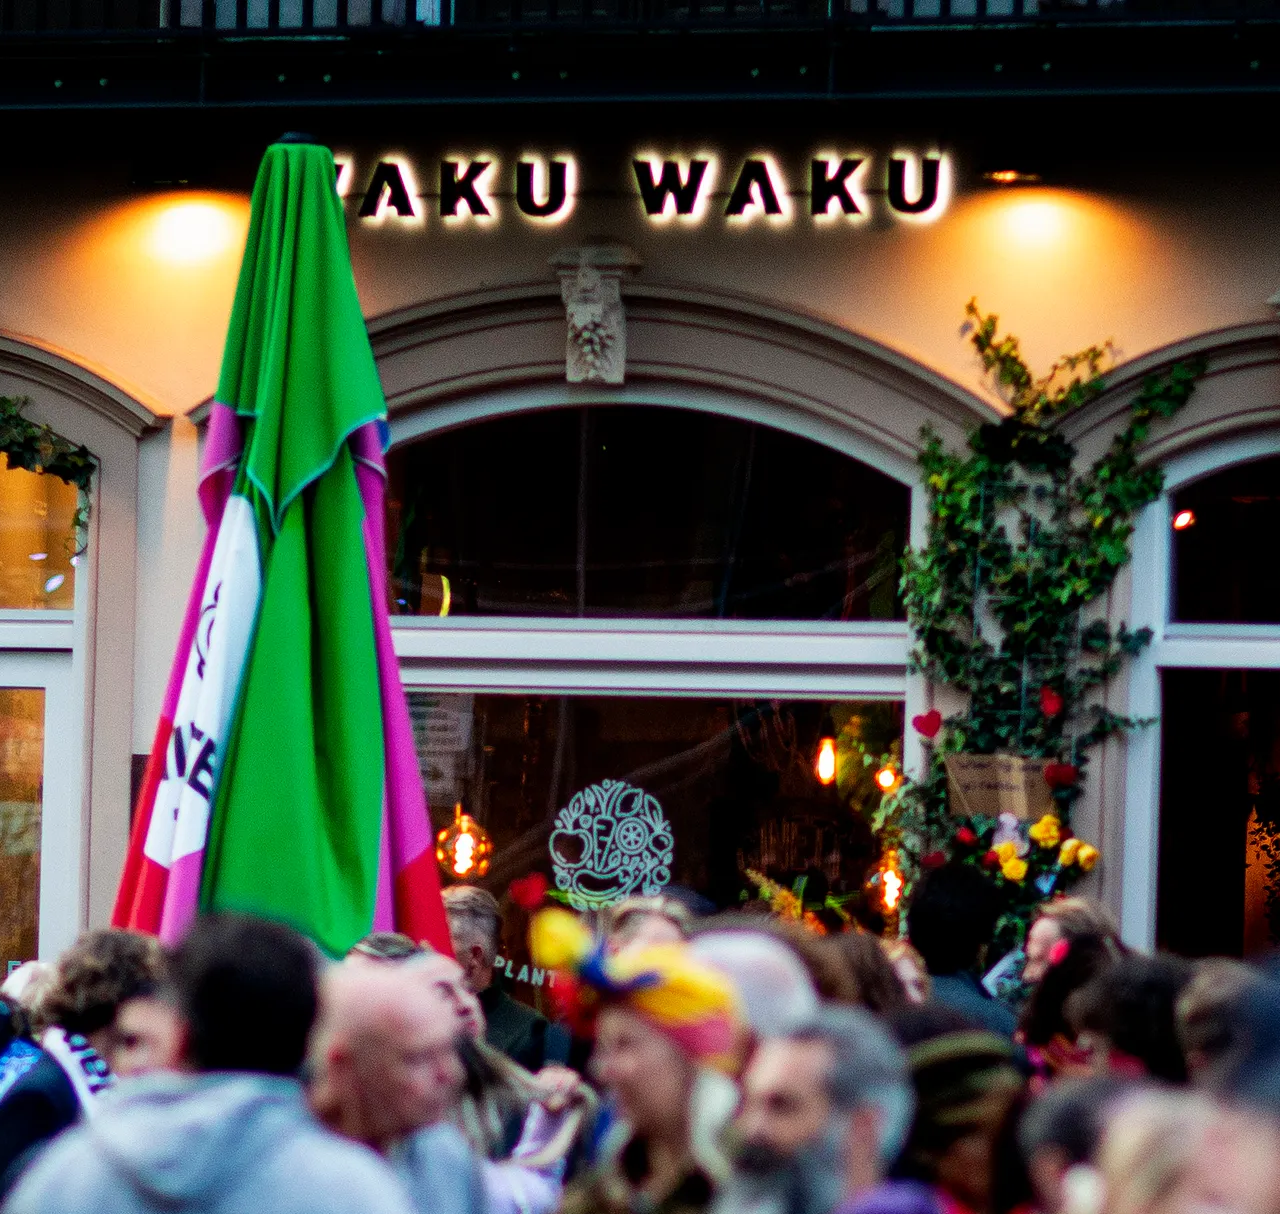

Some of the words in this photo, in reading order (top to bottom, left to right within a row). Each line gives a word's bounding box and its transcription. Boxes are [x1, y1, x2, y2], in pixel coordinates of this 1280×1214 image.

[333, 156, 571, 219] AKU
[630, 156, 943, 219] WAKU
[493, 954, 556, 990] PLANT
